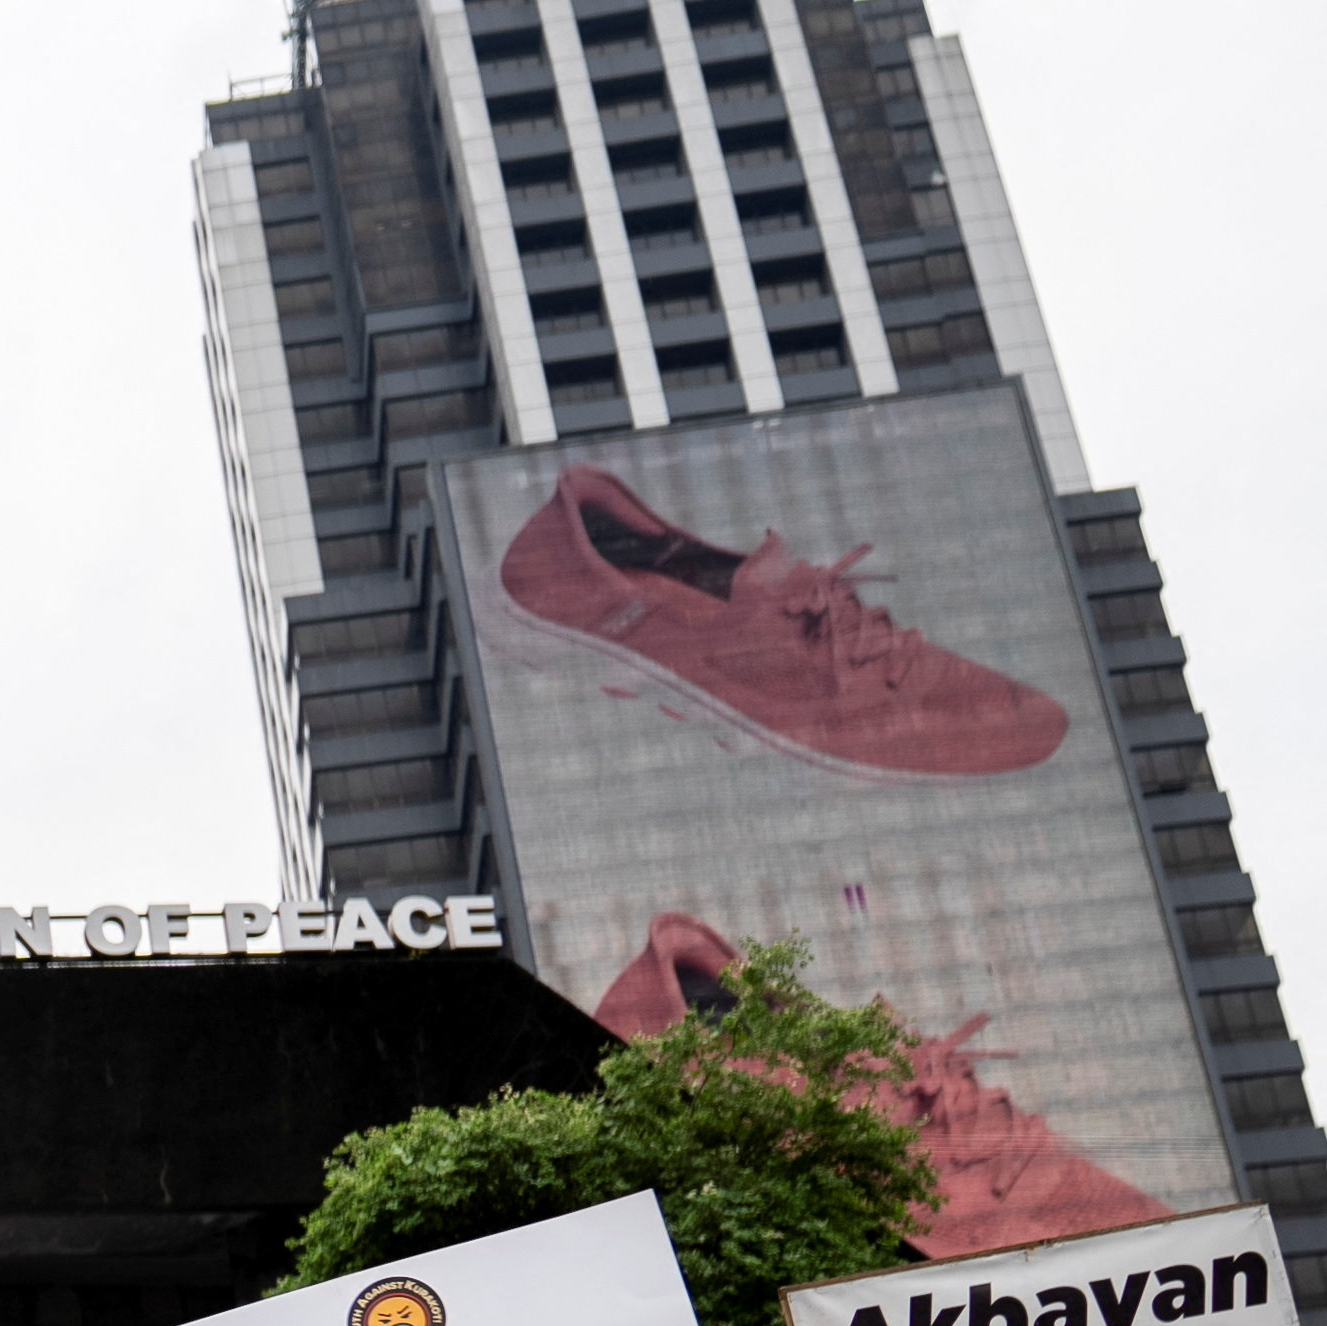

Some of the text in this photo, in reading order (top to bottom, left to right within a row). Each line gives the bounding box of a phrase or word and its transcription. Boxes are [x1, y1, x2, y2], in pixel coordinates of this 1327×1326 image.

[83, 903, 191, 957] OF
[225, 895, 504, 954] PEACE
[357, 1281, 405, 1308] AGAINST
